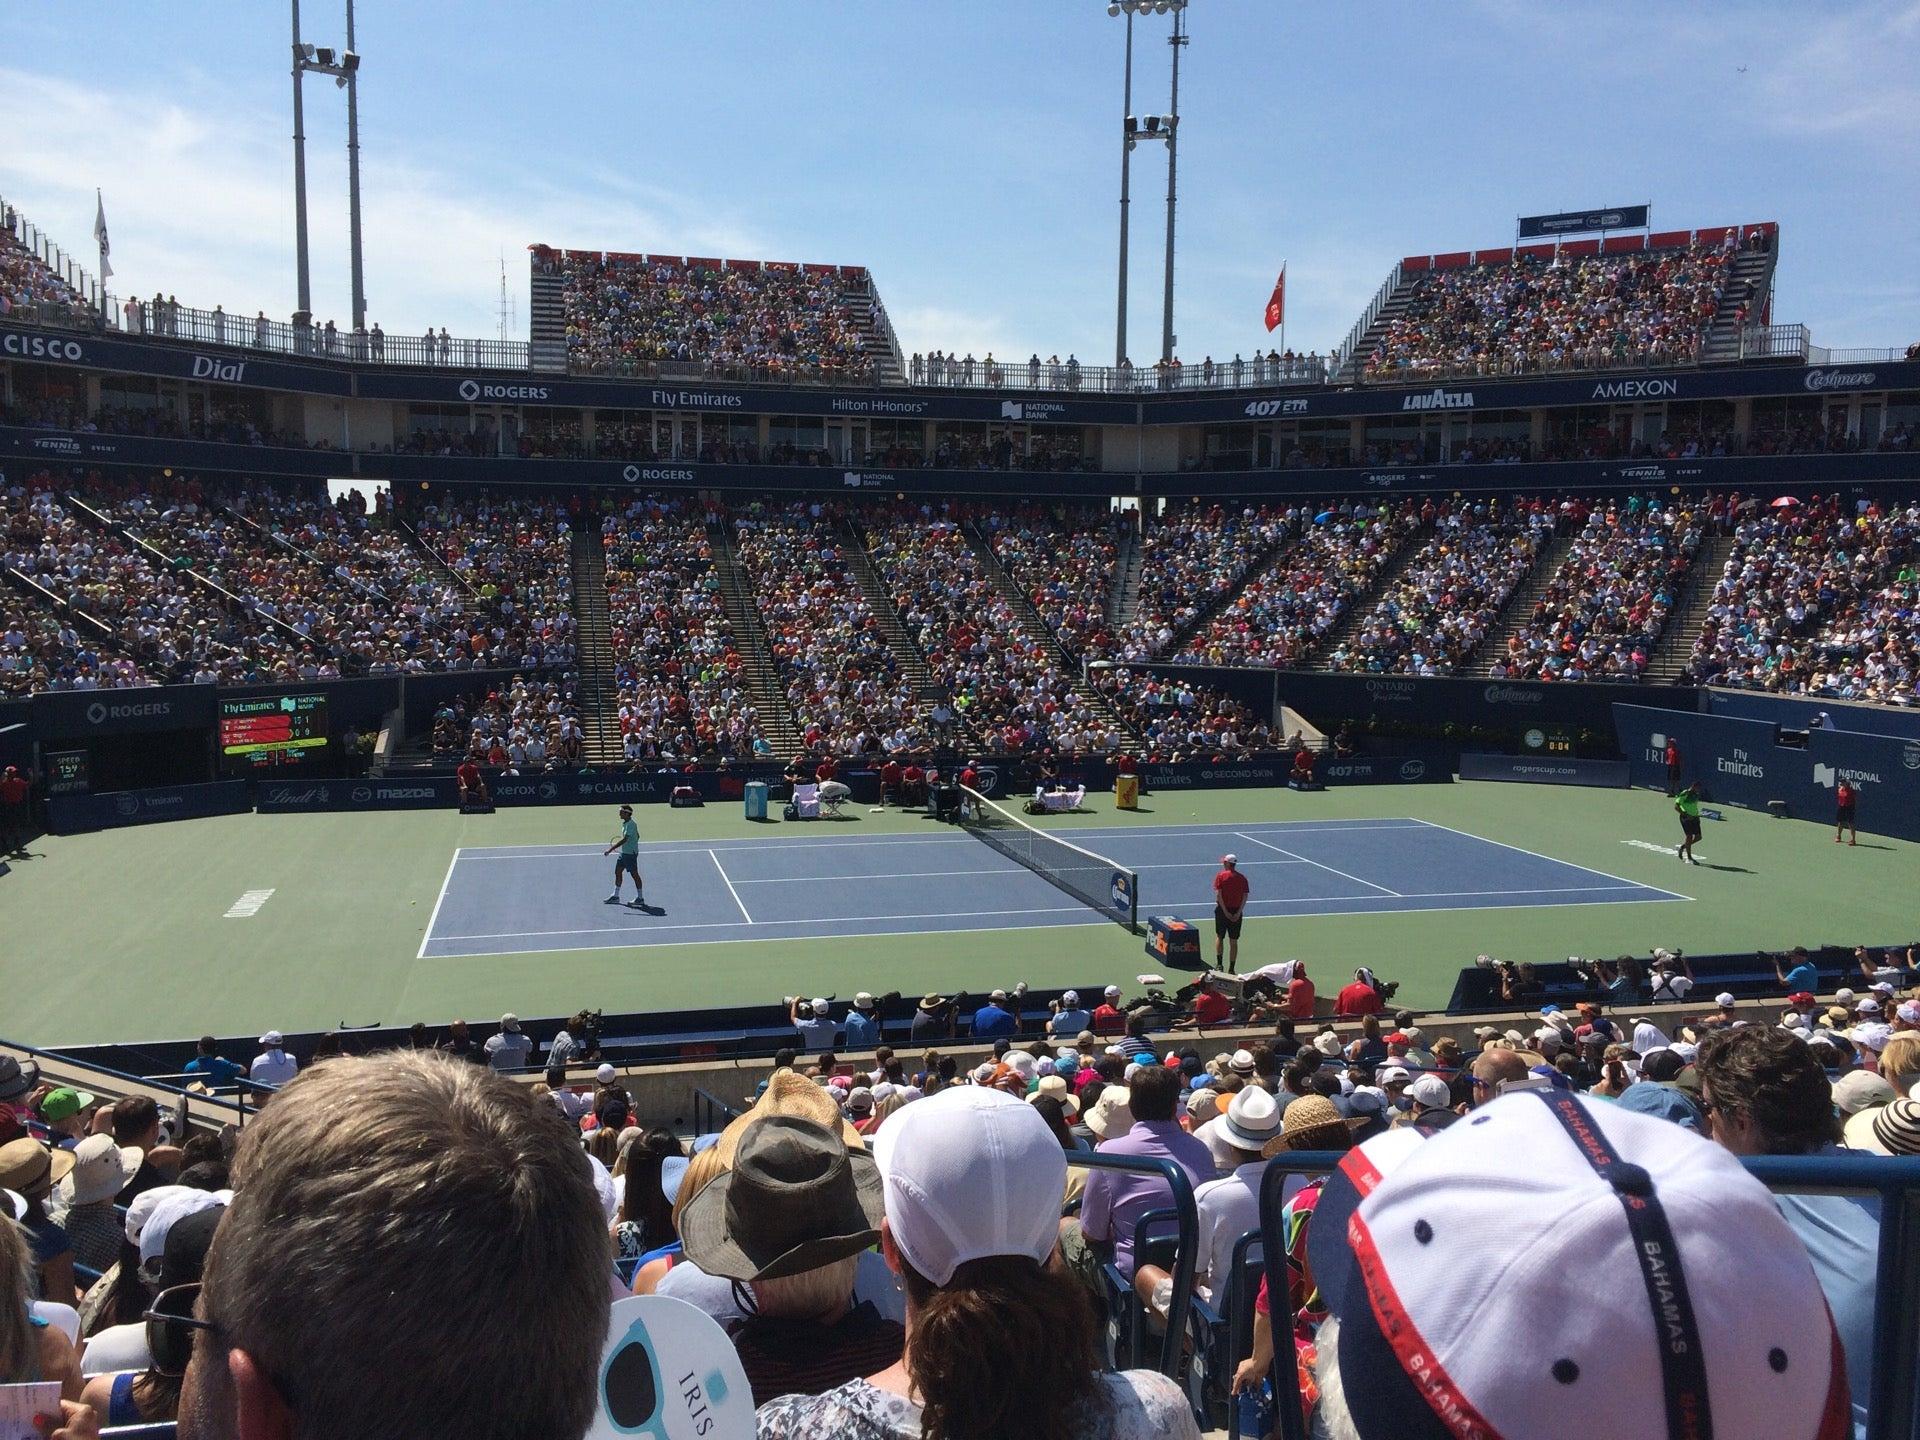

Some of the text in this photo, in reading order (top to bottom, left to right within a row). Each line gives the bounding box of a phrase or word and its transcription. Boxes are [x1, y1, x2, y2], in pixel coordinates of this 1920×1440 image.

[4, 335, 83, 361] CISCO
[192, 356, 246, 383] Dial
[484, 385, 549, 400] ROGERS
[1592, 380, 1677, 399] AMEXON
[652, 391, 742, 408] Fly Emirates
[832, 399, 868, 411] Hilton
[1402, 389, 1475, 411] LAVAZZA
[1025, 403, 1065, 412] NATIONAL
[1244, 399, 1308, 416] 407 ETR
[1025, 411, 1049, 419] BANK
[34, 440, 81, 450] TENNIS
[642, 469, 693, 481] ROGERS
[1365, 680, 1416, 693] ONTARIO
[110, 703, 171, 718] ROGERS
[1734, 748, 1748, 762] Fly
[1159, 767, 1174, 777] Fly
[1214, 769, 1275, 779] SECOND SKIN
[1328, 766, 1353, 777] 407
[1512, 765, 1577, 776] rogerscup.com
[1717, 757, 1764, 778] Emirates
[1145, 774, 1192, 785] Emirates
[1838, 768, 1882, 783] NATIONAL
[376, 787, 436, 800] mazda
[496, 786, 536, 796] xerox
[595, 782, 656, 794] CAMBRIA
[1169, 942, 1200, 954] FedEx
[1556, 1100, 1611, 1167] BAHAMAS
[1643, 1240, 1688, 1355] BAHAMAS
[678, 1370, 714, 1437] IRIS
